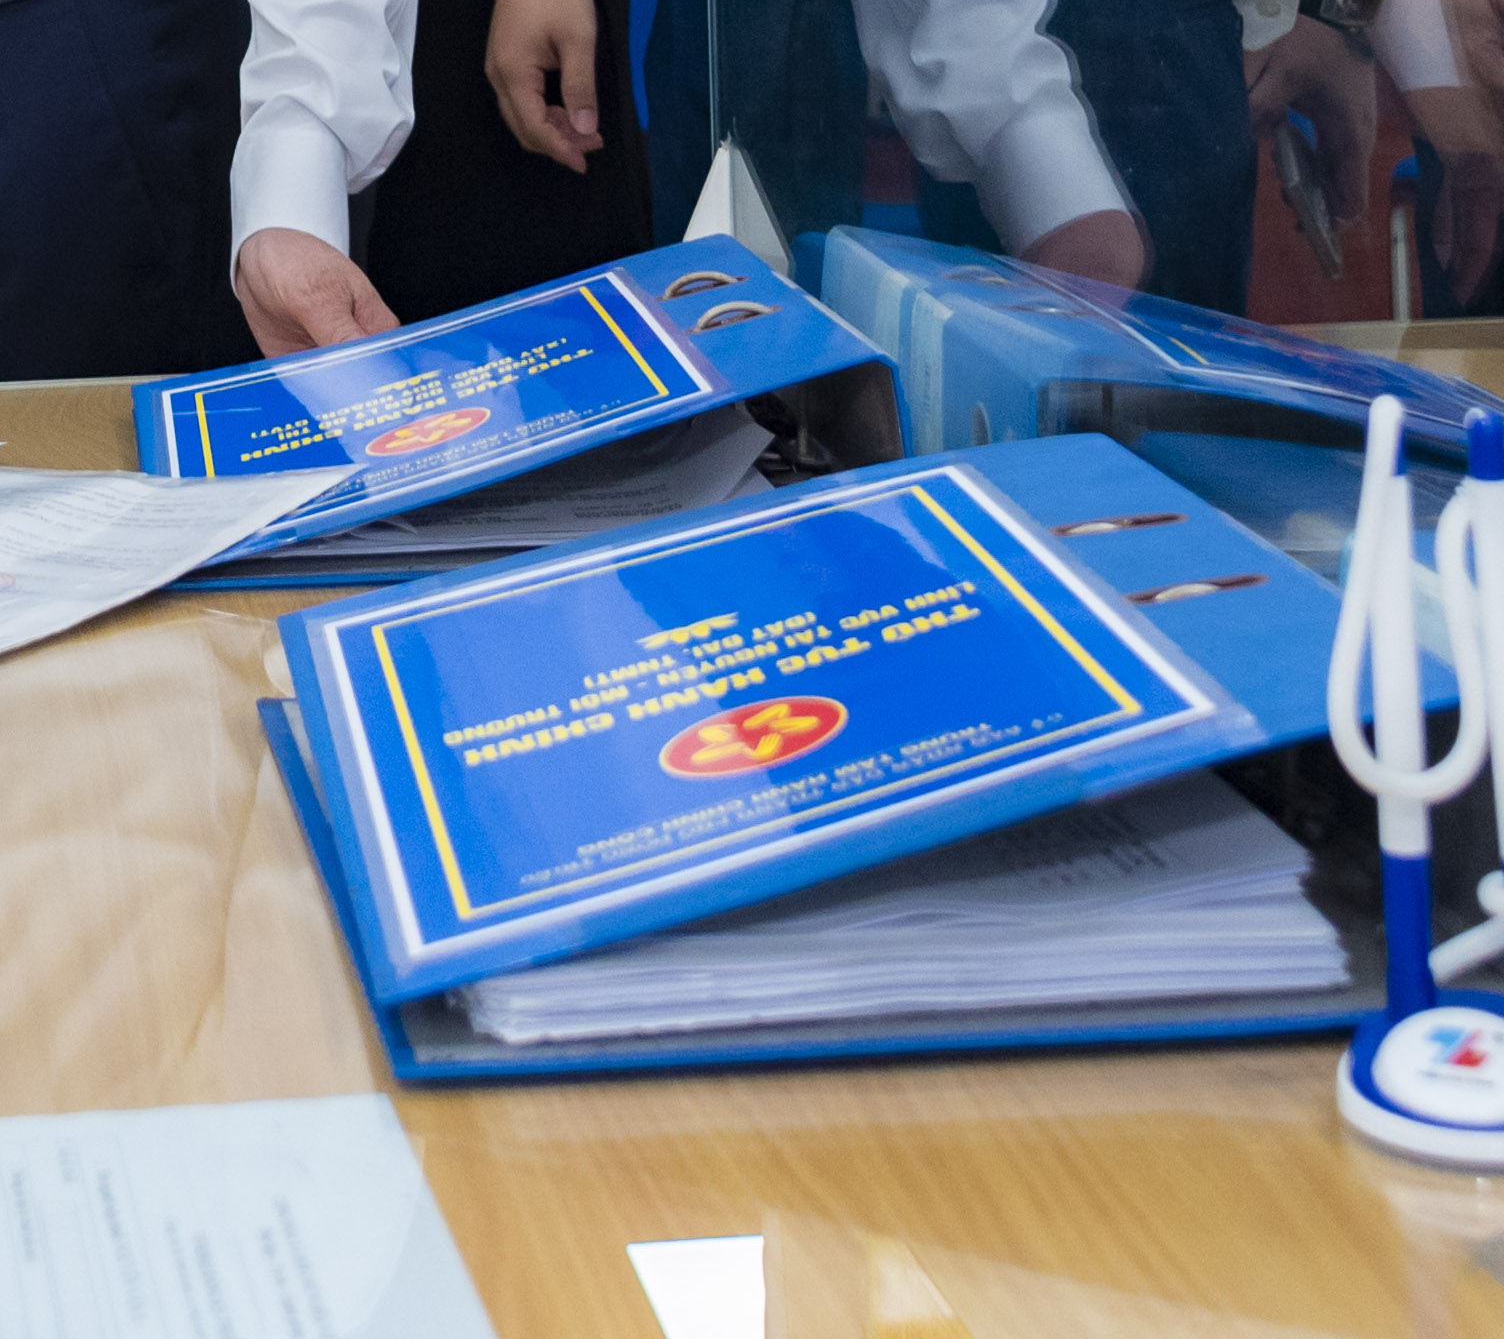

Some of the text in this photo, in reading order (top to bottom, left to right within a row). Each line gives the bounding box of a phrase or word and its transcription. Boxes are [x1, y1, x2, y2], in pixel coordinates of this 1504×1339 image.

[584, 655, 675, 688] TNMT)
[776, 637, 870, 674] TỤC
[465, 713, 614, 765] CHÍNH
